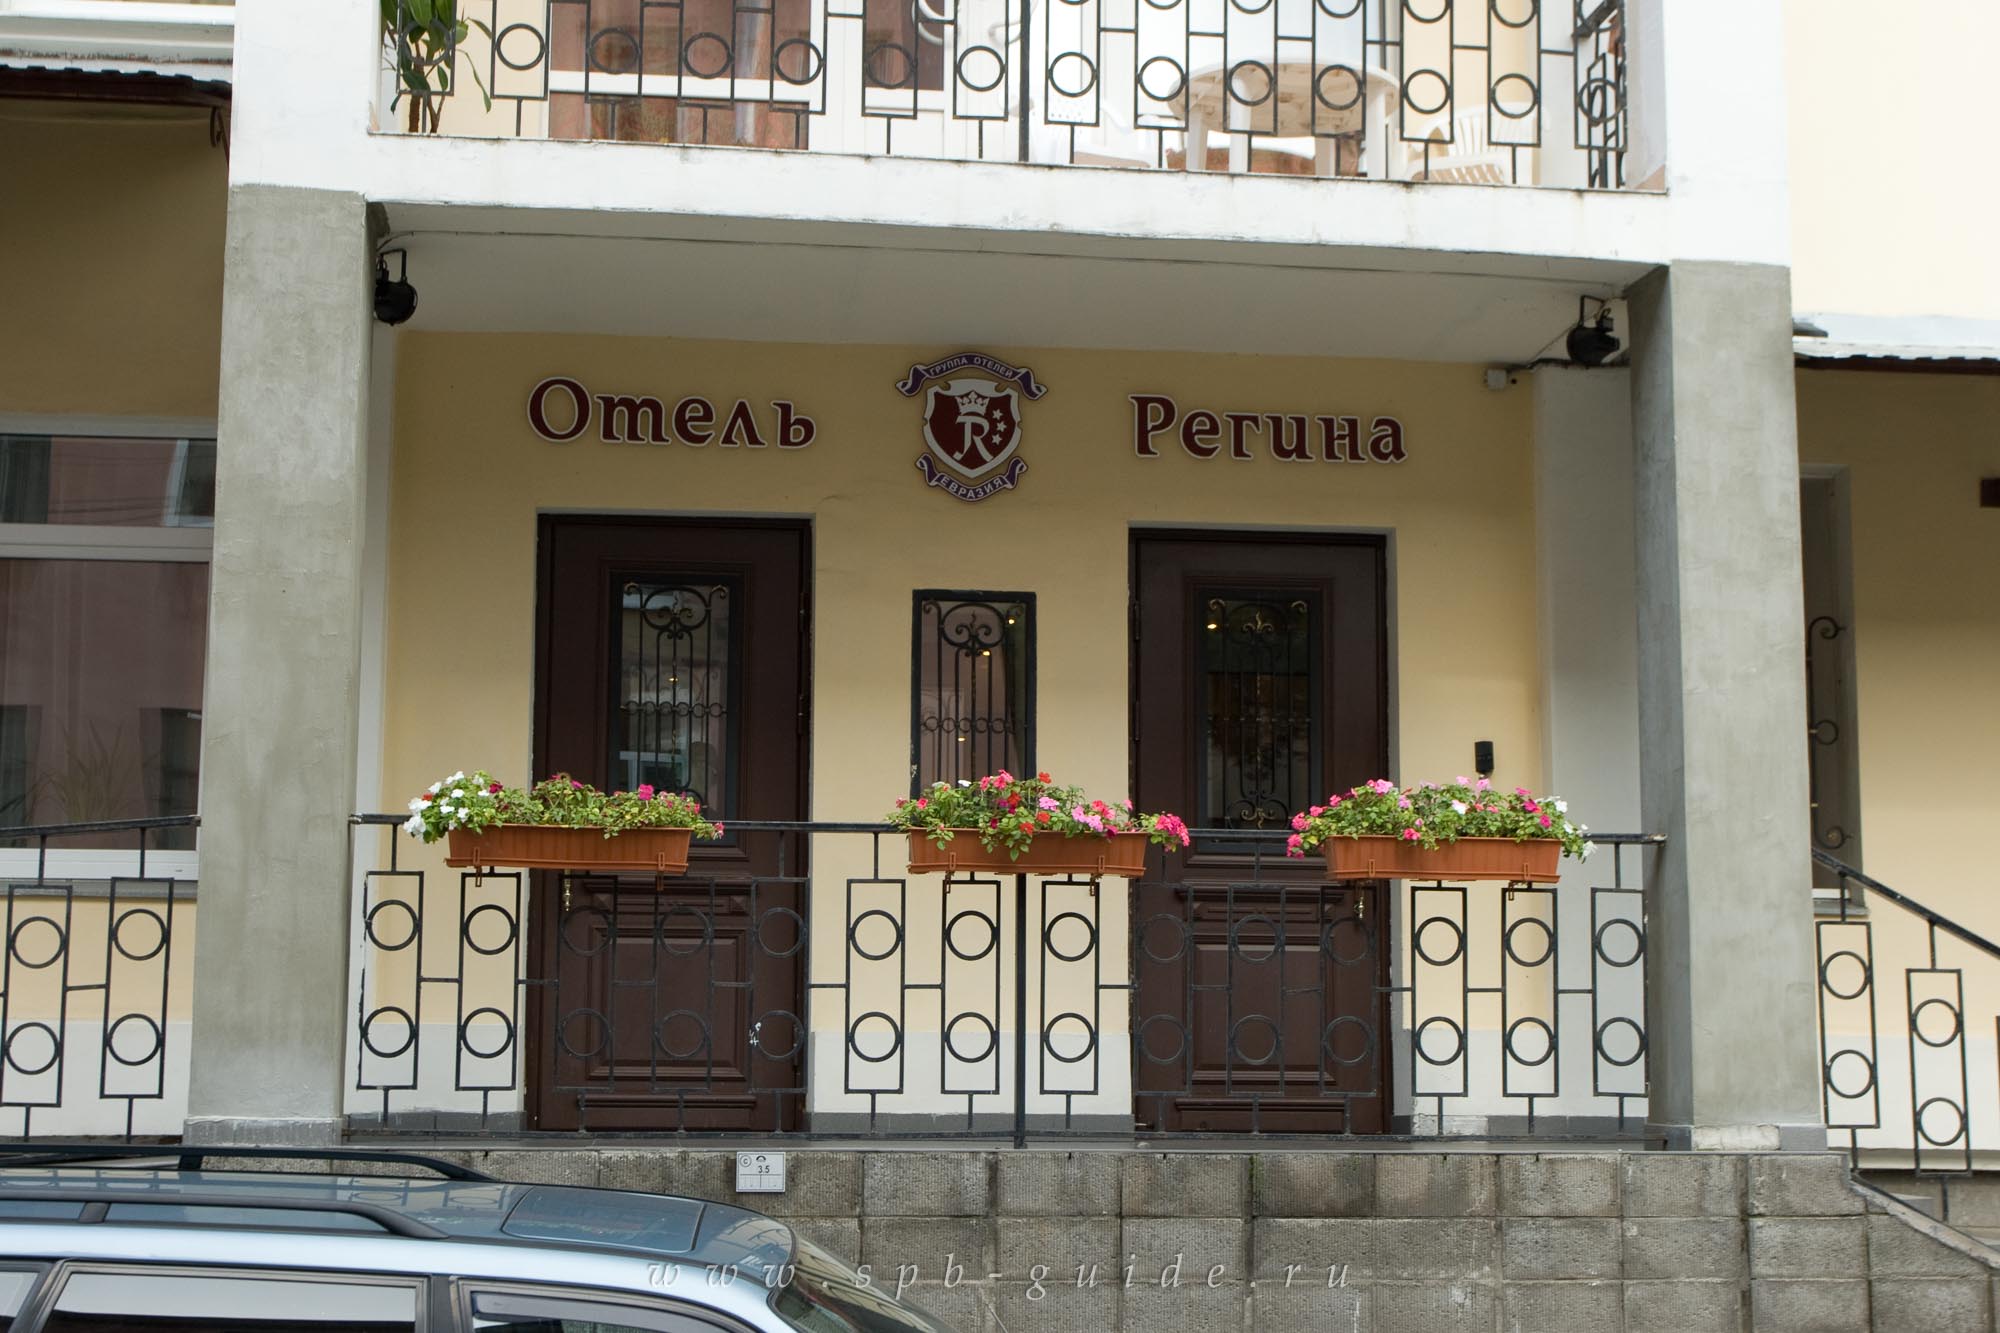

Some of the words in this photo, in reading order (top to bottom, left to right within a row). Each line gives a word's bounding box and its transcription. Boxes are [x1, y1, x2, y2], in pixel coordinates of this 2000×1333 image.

[929, 356, 968, 376] ГРУППА
[973, 356, 1014, 378] ОТЕЛЕЙ
[527, 376, 817, 449] Отель
[1128, 394, 1409, 463] Регина
[940, 477, 1003, 499] ЕВРАЗИЯ
